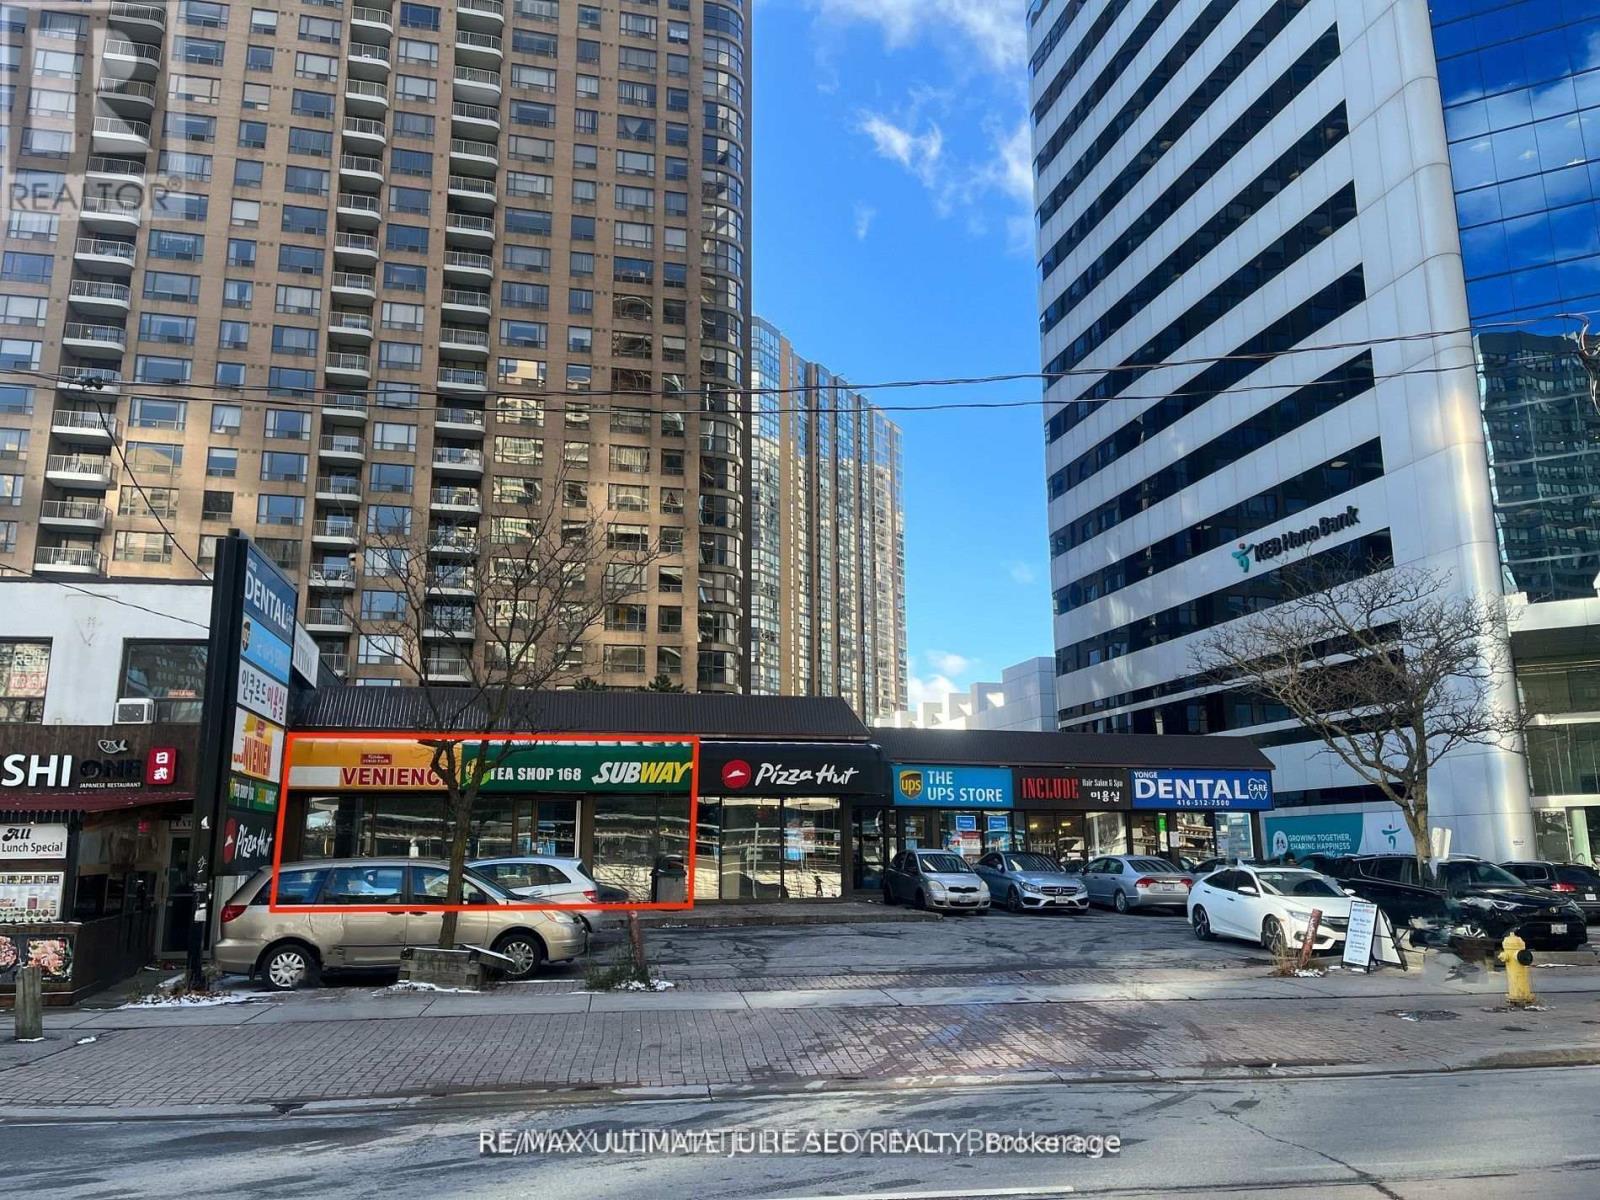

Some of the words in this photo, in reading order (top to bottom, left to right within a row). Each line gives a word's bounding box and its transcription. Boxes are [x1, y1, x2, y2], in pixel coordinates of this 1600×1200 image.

[1318, 505, 1360, 536] Bank
[244, 570, 287, 630] DENTAL
[1, 753, 73, 787] SHI
[80, 758, 142, 778] ONE
[342, 767, 449, 786] VENIENC
[490, 767, 514, 781] TEA
[517, 767, 554, 781] SHOP
[556, 767, 582, 781] 168
[591, 761, 694, 785] SUBWAY
[754, 762, 814, 786] Pizza
[815, 763, 860, 785] Hut
[927, 770, 954, 785] THE
[901, 779, 921, 795] ups
[1021, 778, 1080, 799] INCLUDE
[1113, 779, 1124, 788] Spa
[1134, 778, 1249, 800] DENTAL
[1247, 784, 1268, 792] CARE
[927, 787, 955, 801] UPS
[959, 787, 1003, 803] STORE
[2, 828, 32, 842] All
[234, 823, 258, 860] Pizza
[256, 827, 273, 857] Hut
[1288, 834, 1317, 842] GROWING
[1317, 832, 1352, 842] TOGETHER,
[1, 842, 29, 853] Lunch
[30, 841, 63, 854] Special
[1290, 842, 1316, 850] SHARING
[1316, 842, 1351, 850] HAPPINESS
